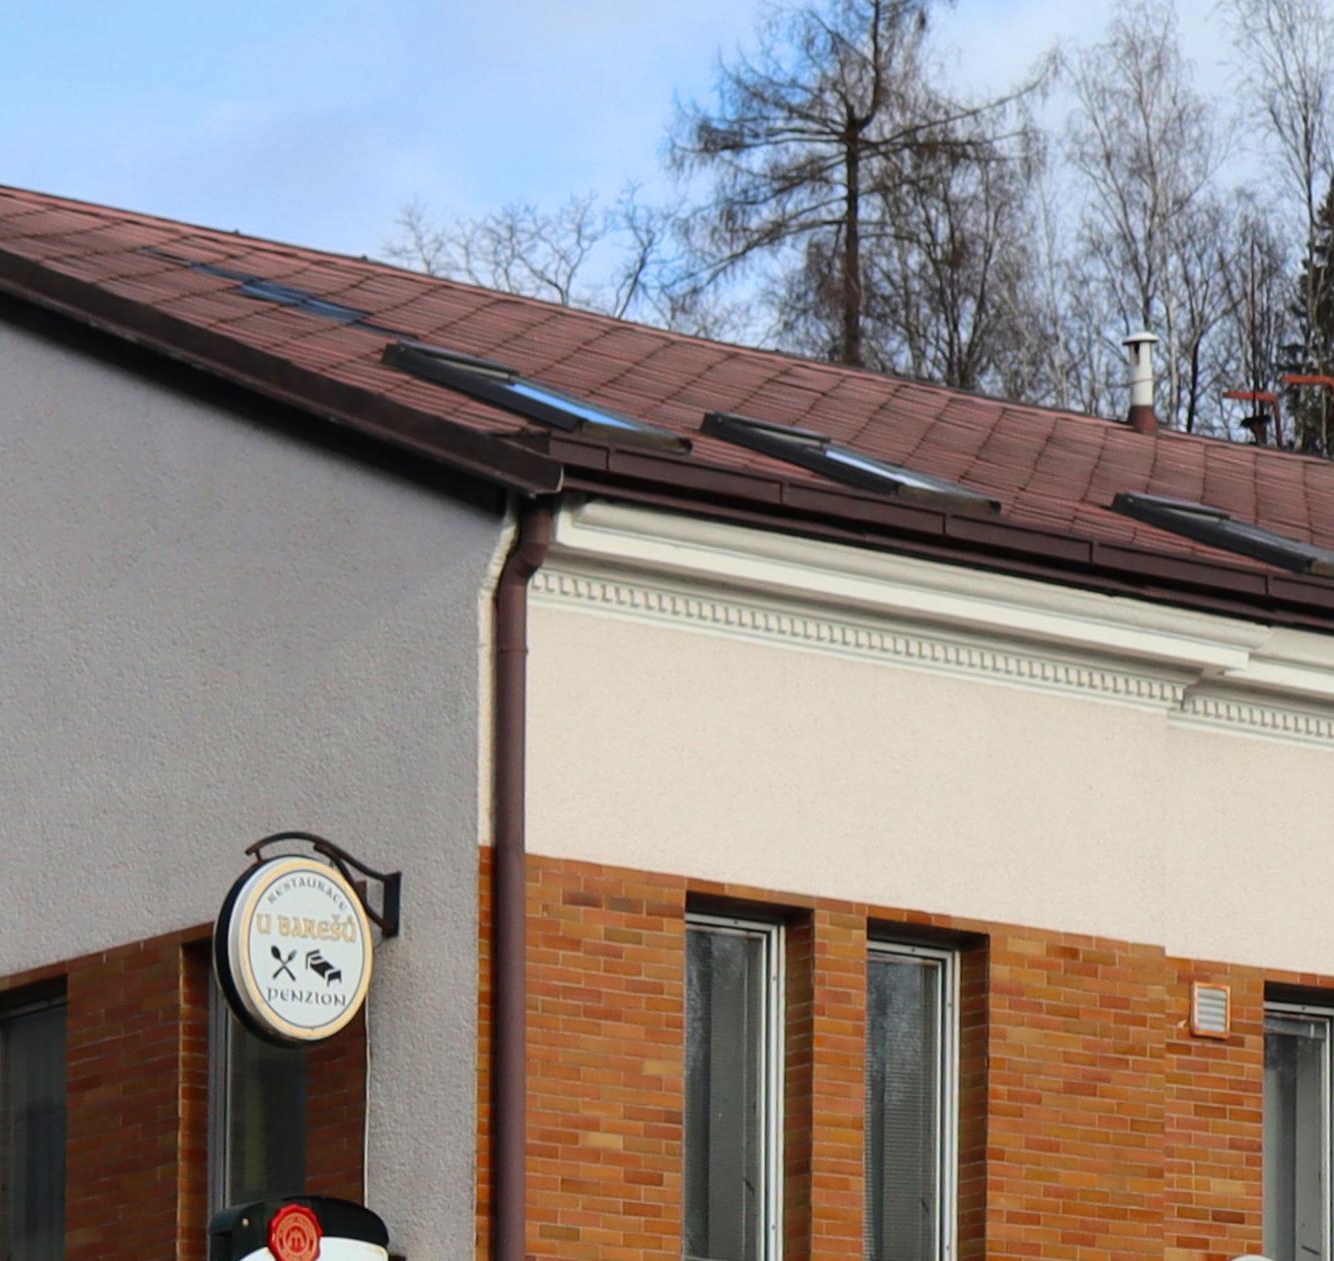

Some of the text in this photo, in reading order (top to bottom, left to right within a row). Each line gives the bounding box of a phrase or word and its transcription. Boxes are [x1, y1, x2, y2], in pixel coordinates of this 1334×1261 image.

[267, 877, 347, 911] RESTAURACE
[256, 913, 271, 935] U
[267, 987, 347, 1006] PENZION
